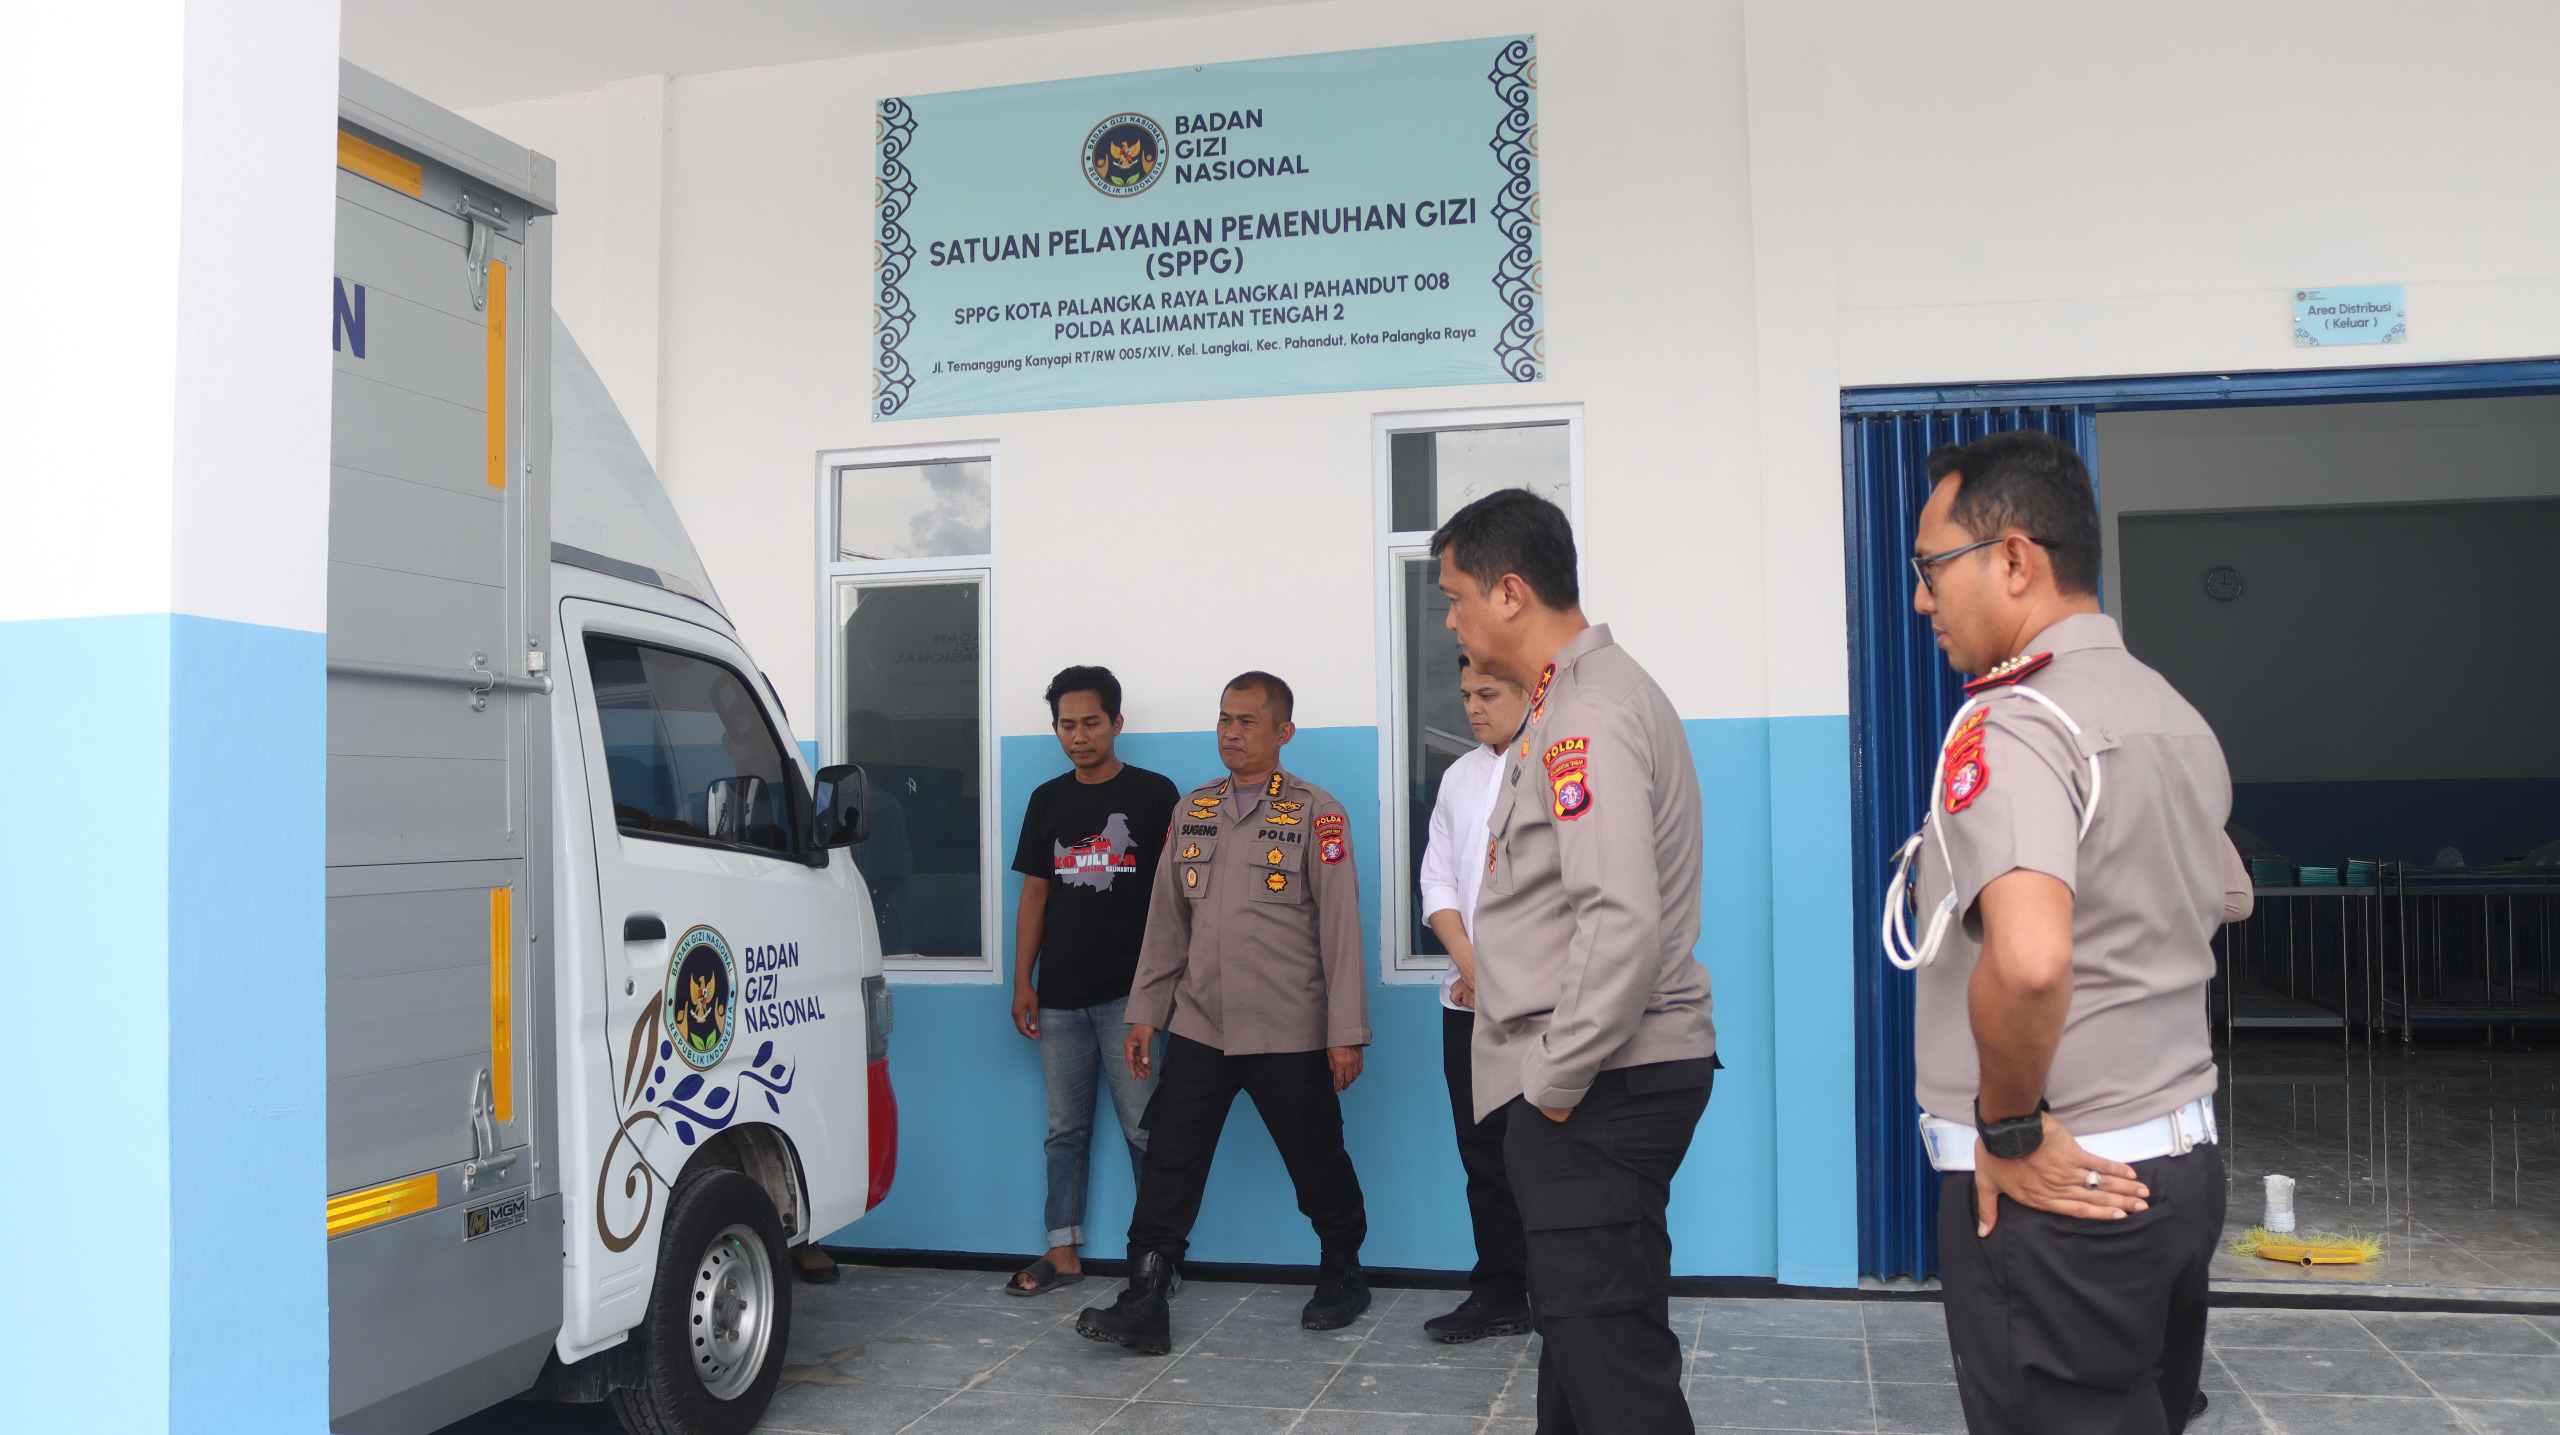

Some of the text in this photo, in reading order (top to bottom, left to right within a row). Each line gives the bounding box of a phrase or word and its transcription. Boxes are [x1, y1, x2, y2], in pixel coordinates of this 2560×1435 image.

[1088, 116, 1163, 150] BADAN GIZI NASIONAL
[1175, 108, 1263, 135] BADAN
[1175, 136, 1227, 159] GIZI
[1088, 161, 1163, 194] REPUBLIK INDONESIA
[1175, 154, 1310, 185] NASIONAL
[929, 197, 1476, 267] SATUAN PELAYANAN PEMENUHAN GIZI
[1145, 246, 1244, 281] (SPPG)
[954, 271, 1450, 325] SPPG KOTA PALANGKA RAYA LANGKAI PAHANDUT 008
[2307, 302, 2392, 316] Area Distribusi
[1054, 303, 1344, 341] POLDA KALIMANTAN TENGAH 2
[2332, 318, 2370, 329] Keluar
[932, 362, 944, 375] Jl.
[947, 357, 1022, 374] Temanggung
[1025, 352, 1072, 369] Kanyapi
[1075, 349, 1116, 364] RT/RW
[1177, 343, 1199, 357] Kel.
[1256, 338, 1282, 352] Kec.
[1350, 331, 1379, 346] Kota
[1382, 328, 1442, 345] Palangka
[1444, 327, 1477, 342] Raya
[1545, 739, 1585, 764] POLDA
[1181, 824, 1218, 837] SUGENG
[1258, 829, 1302, 844] POLRI
[1316, 816, 1342, 827] POLDA
[1054, 853, 1137, 868] KOVILIKA
[671, 932, 733, 977] BADAN GIZI NASIONAL
[745, 941, 799, 974] BADAN
[745, 973, 778, 1004] GIZI
[744, 995, 826, 1034] NASIONAL
[668, 1006, 733, 1065] REPUBLIK INDONESIA
[490, 1200, 525, 1222] MGM
